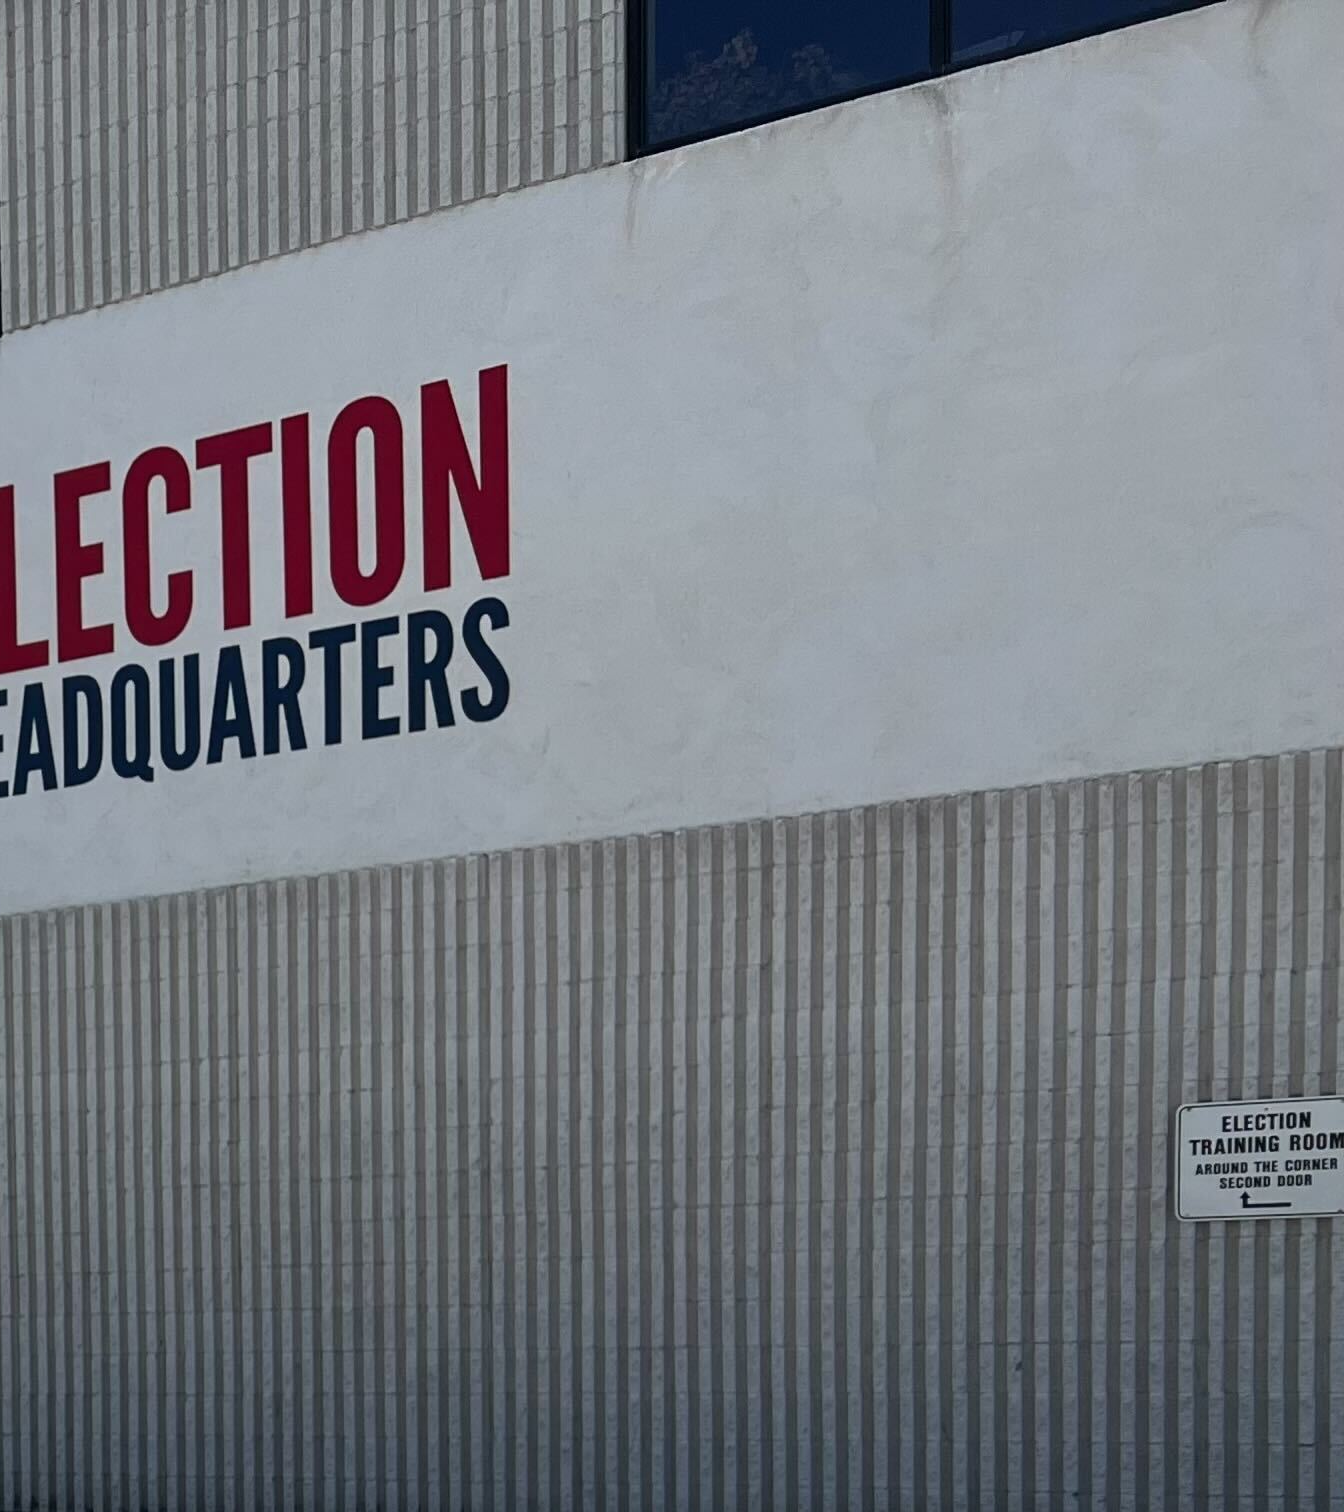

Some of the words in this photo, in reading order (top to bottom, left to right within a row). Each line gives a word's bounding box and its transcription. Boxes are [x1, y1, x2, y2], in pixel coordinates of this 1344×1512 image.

[1221, 1111, 1312, 1133] ELECTION
[1188, 1134, 1281, 1156] TRAINING
[1288, 1132, 1344, 1152] ROOM
[1195, 1161, 1249, 1176] AROUND
[1254, 1160, 1279, 1173] THE
[1284, 1157, 1339, 1172] CORNER
[1218, 1175, 1271, 1190] SECOND
[1277, 1174, 1313, 1187] DOOR
